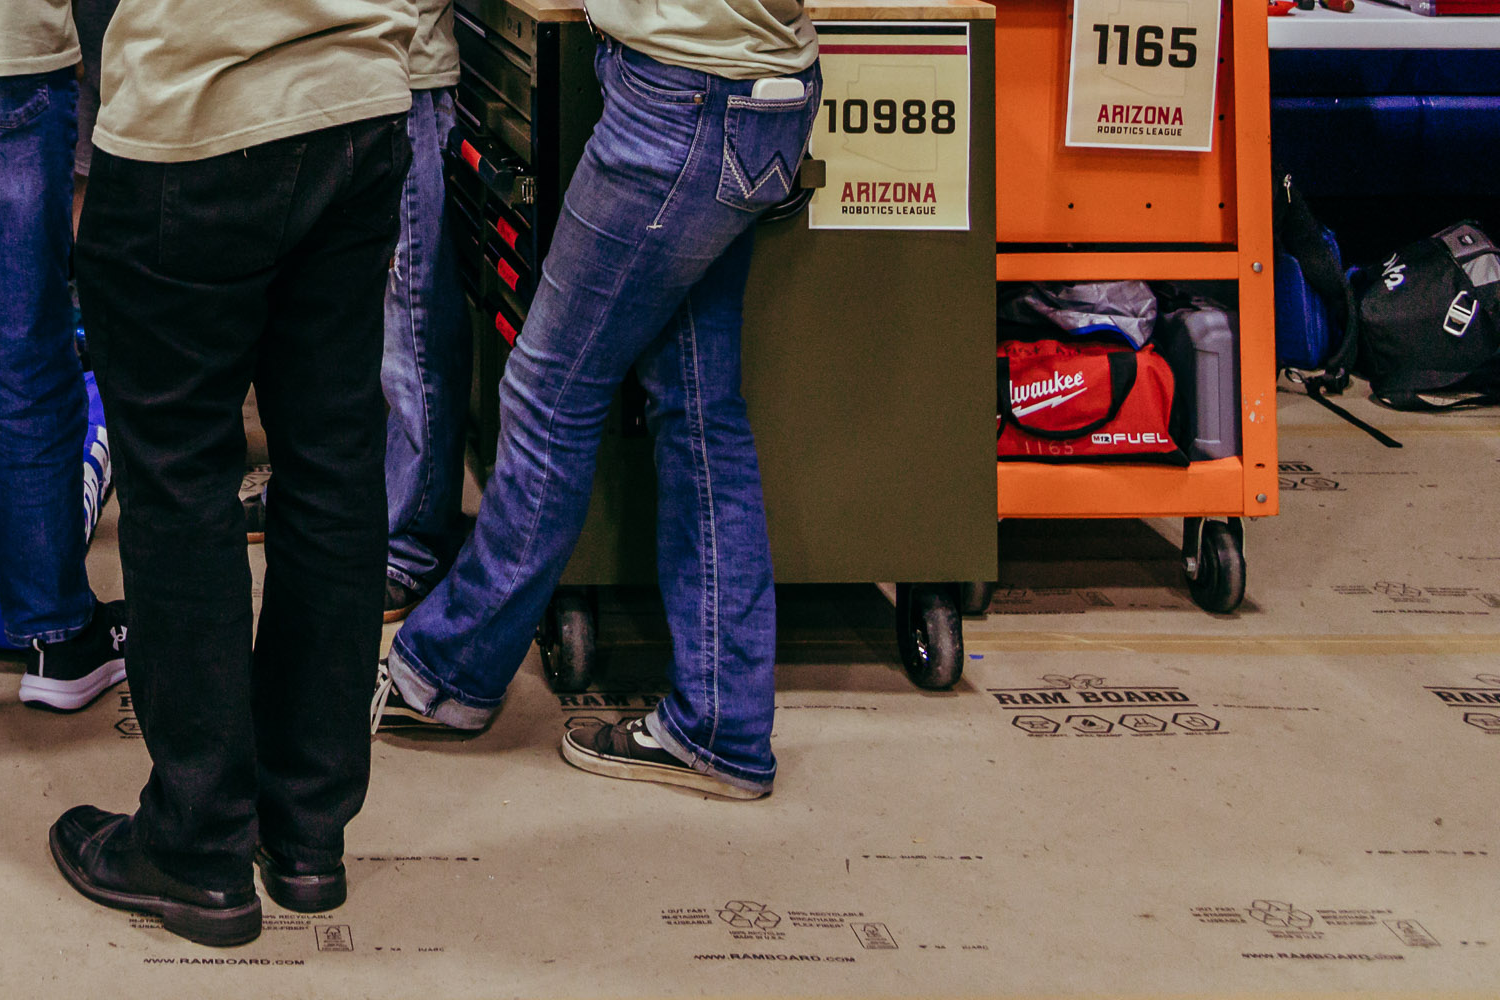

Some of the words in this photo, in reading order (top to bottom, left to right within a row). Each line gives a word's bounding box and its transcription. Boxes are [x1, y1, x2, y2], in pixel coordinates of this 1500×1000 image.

[1093, 23, 1197, 68] 1165
[822, 99, 956, 135] 10988
[1097, 104, 1184, 125] ARIZONA
[1097, 126, 1144, 135] ROBOTICS
[1146, 128, 1183, 137] LEAGUE
[840, 182, 937, 203] ARIZONA
[841, 205, 894, 215] ROBOTICS
[896, 206, 936, 215] LEAGUE
[1112, 433, 1168, 444] FUEL
[1025, 441, 1074, 455] 1165
[561, 694, 631, 707] RAM
[994, 691, 1070, 705] RAM
[1076, 690, 1190, 704] BOARD
[143, 957, 305, 966] WWW.RAMBOARD.COM
[693, 953, 856, 963] WWW.RAMBOARD.COM
